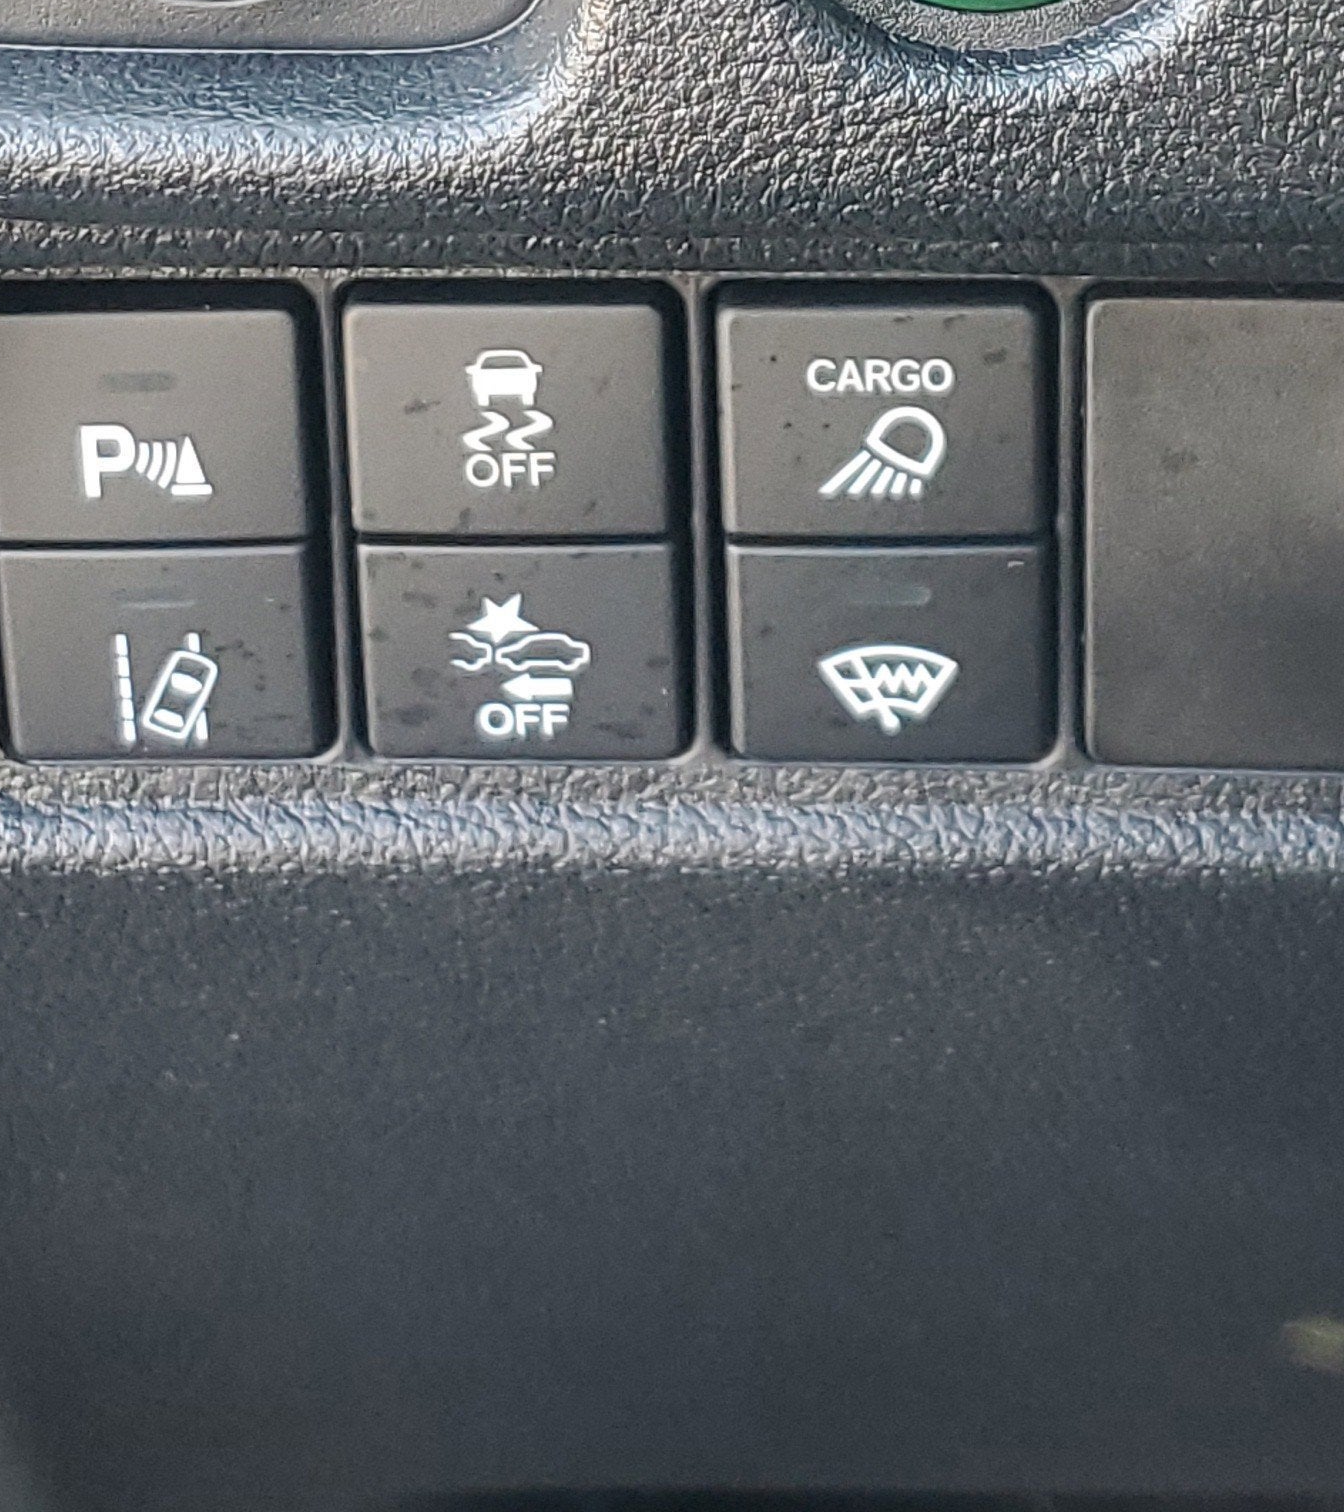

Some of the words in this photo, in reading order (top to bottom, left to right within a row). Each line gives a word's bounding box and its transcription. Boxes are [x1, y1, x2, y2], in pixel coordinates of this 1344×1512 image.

[806, 358, 955, 393] CARGO
[465, 451, 556, 488] OFF
[477, 701, 570, 738] OFF
